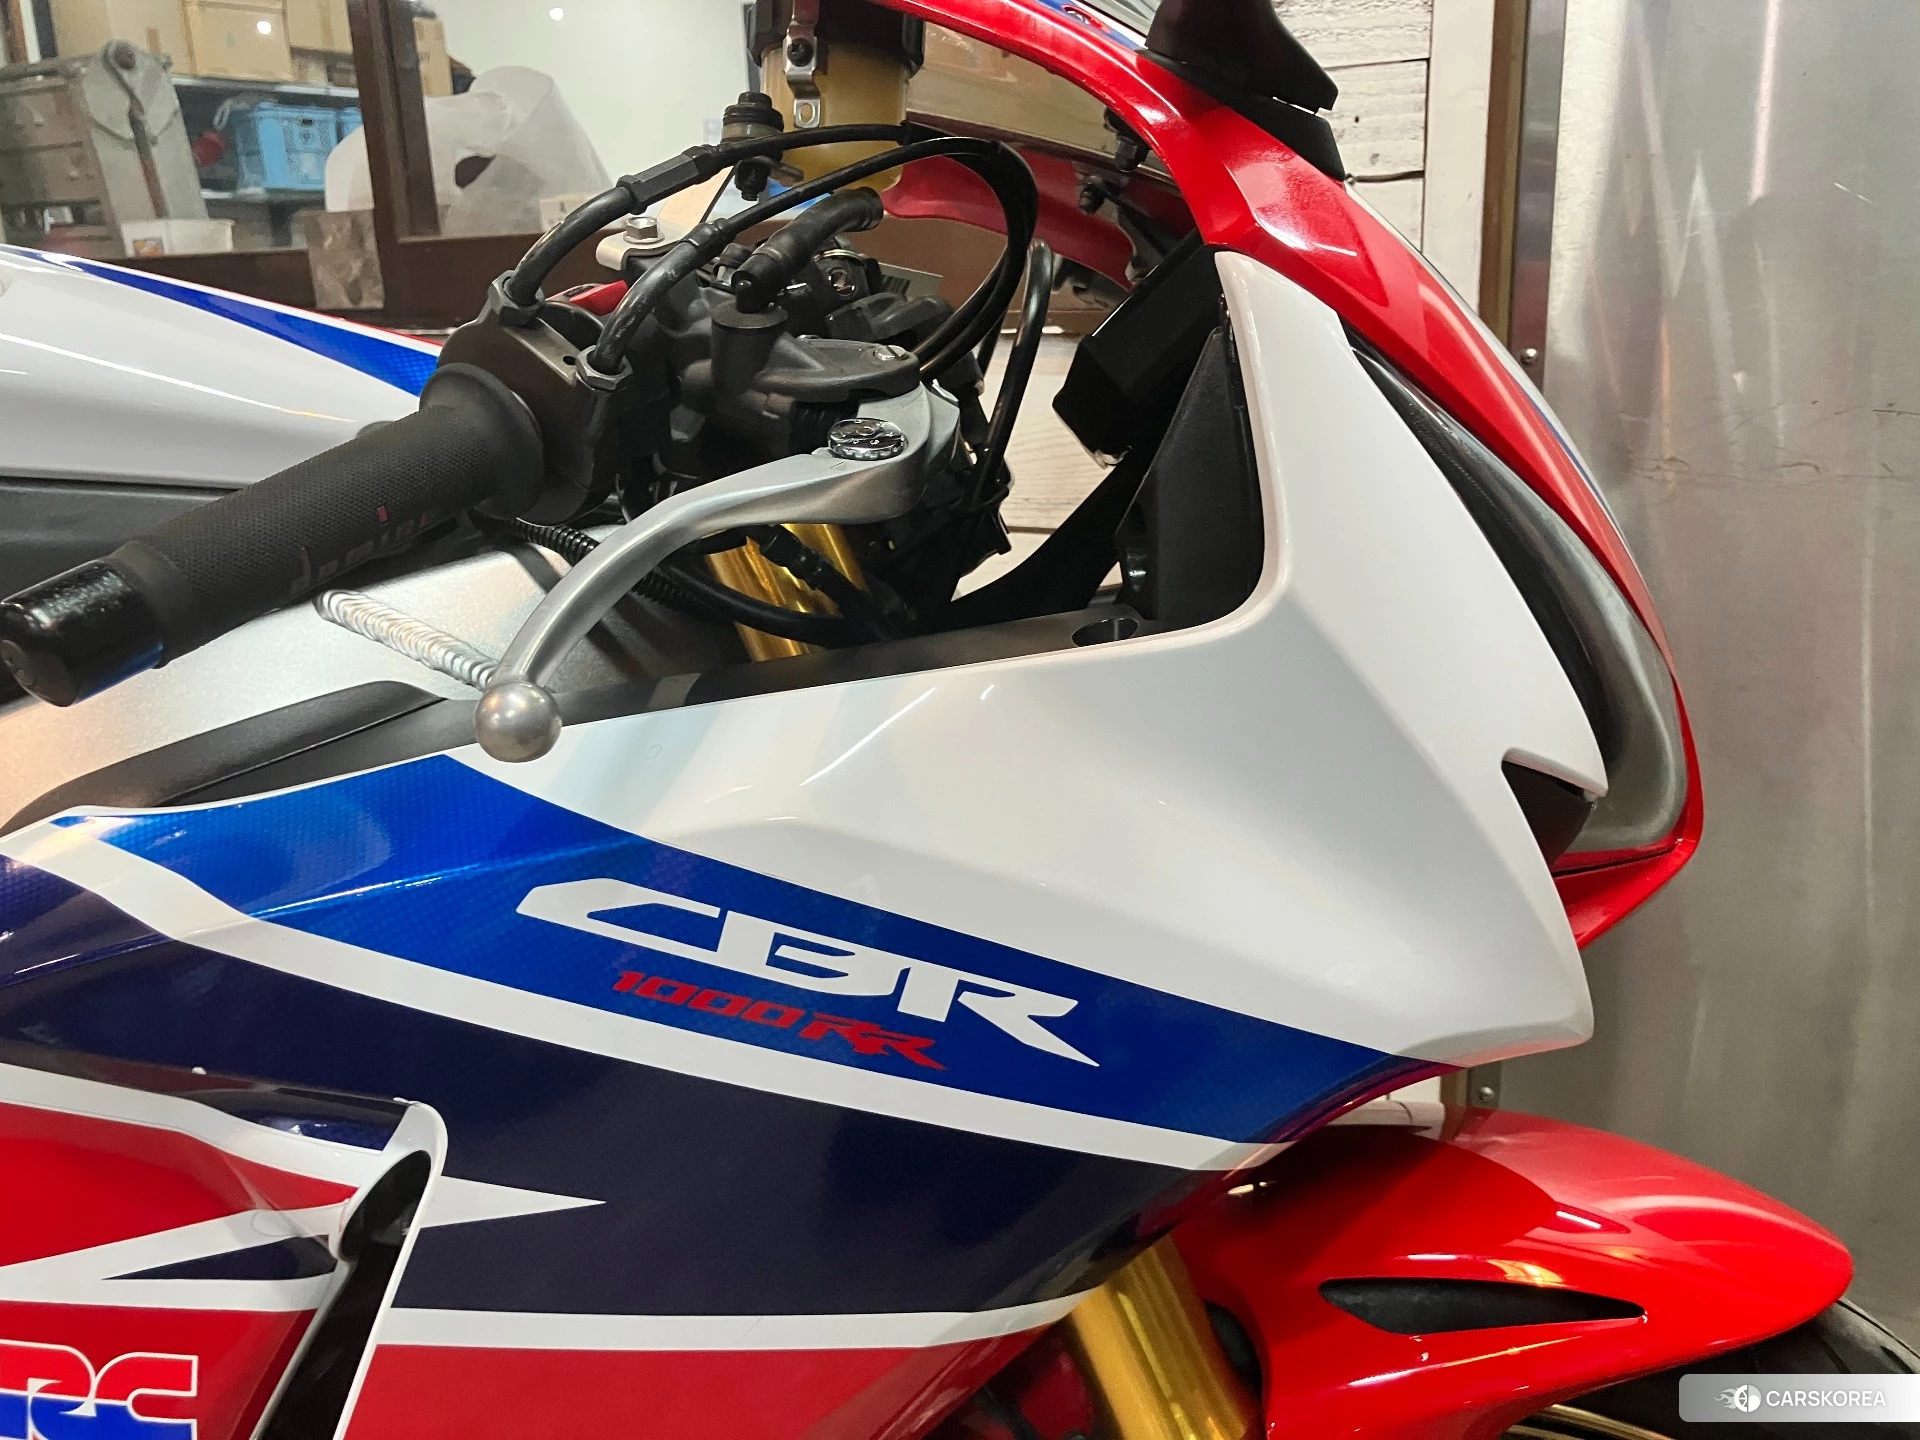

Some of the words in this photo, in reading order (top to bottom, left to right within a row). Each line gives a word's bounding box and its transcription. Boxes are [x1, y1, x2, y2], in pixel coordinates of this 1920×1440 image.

[516, 877, 1100, 1067] CBR
[614, 969, 947, 1071] 1000RR
[0, 1339, 198, 1440] RC
